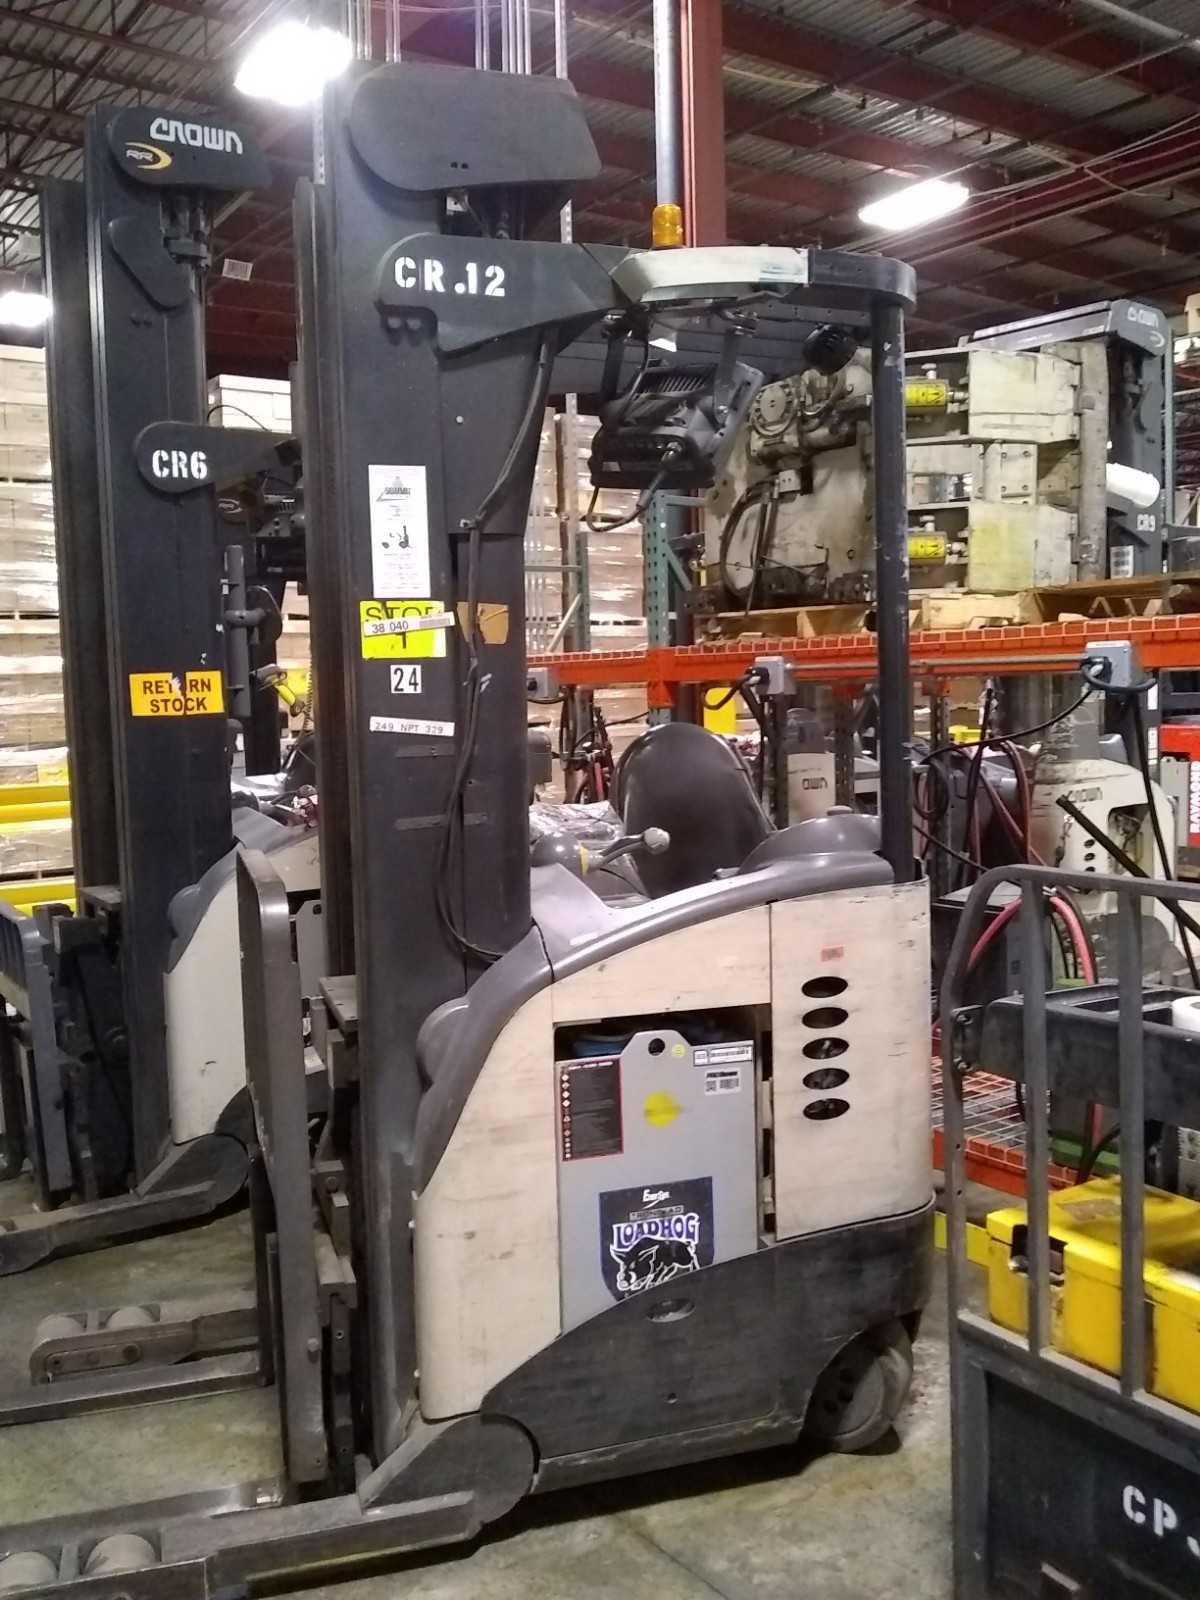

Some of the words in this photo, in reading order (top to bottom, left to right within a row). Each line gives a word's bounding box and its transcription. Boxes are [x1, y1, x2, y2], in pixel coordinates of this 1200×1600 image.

[150, 117, 243, 154] CROWN
[152, 449, 208, 479] CR6
[142, 679, 212, 695] RETRN
[394, 667, 419, 692] 24
[150, 697, 207, 713] STOCK
[613, 1213, 700, 1252] LOADHOG
